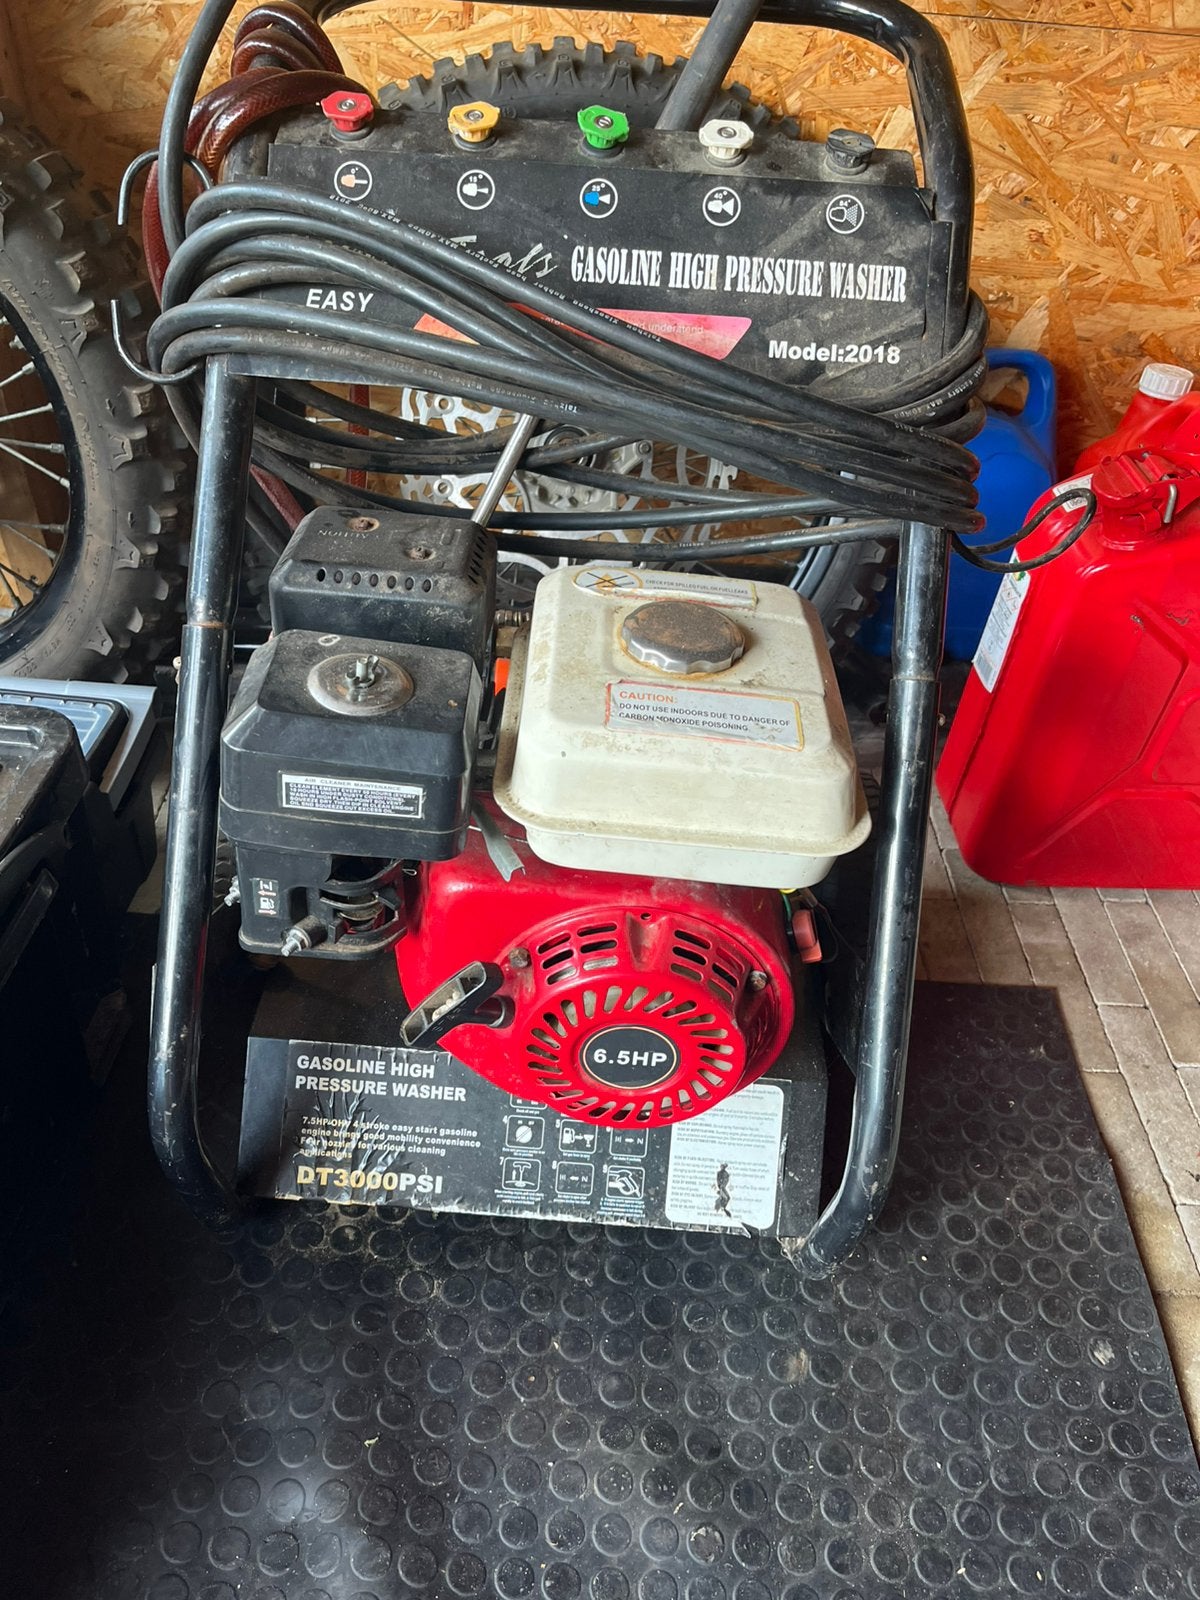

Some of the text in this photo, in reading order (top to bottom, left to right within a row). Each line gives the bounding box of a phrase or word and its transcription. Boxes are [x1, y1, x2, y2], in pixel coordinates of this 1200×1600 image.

[465, 249, 500, 269] Factory
[570, 245, 663, 287] GASOLINE
[668, 252, 720, 291] HIGH
[723, 255, 825, 297] PRESSURE
[829, 262, 907, 303] WASHER
[306, 288, 374, 313] EASY
[768, 340, 901, 365] Model:2018
[618, 712, 655, 721] CARBON
[670, 707, 709, 717] INDOORS
[710, 711, 728, 720] DUE
[729, 713, 741, 721] TO
[742, 715, 778, 726] DANGER
[297, 1055, 435, 1079] GASOLINE HIGH
[593, 1048, 668, 1067] 6.5HP
[295, 1075, 467, 1101] PRESSURE WASHER
[301, 1127, 332, 1137] engine
[363, 1132, 385, 1141] good
[387, 1133, 424, 1145] mobility
[425, 1137, 481, 1148] convenience
[392, 1125, 413, 1134] easy
[415, 1125, 438, 1134] start
[439, 1128, 478, 1138] gasoline
[358, 1140, 372, 1149] for
[373, 1142, 406, 1152] various
[407, 1144, 446, 1157] cleaning
[297, 1166, 443, 1194] DT3000PSI
